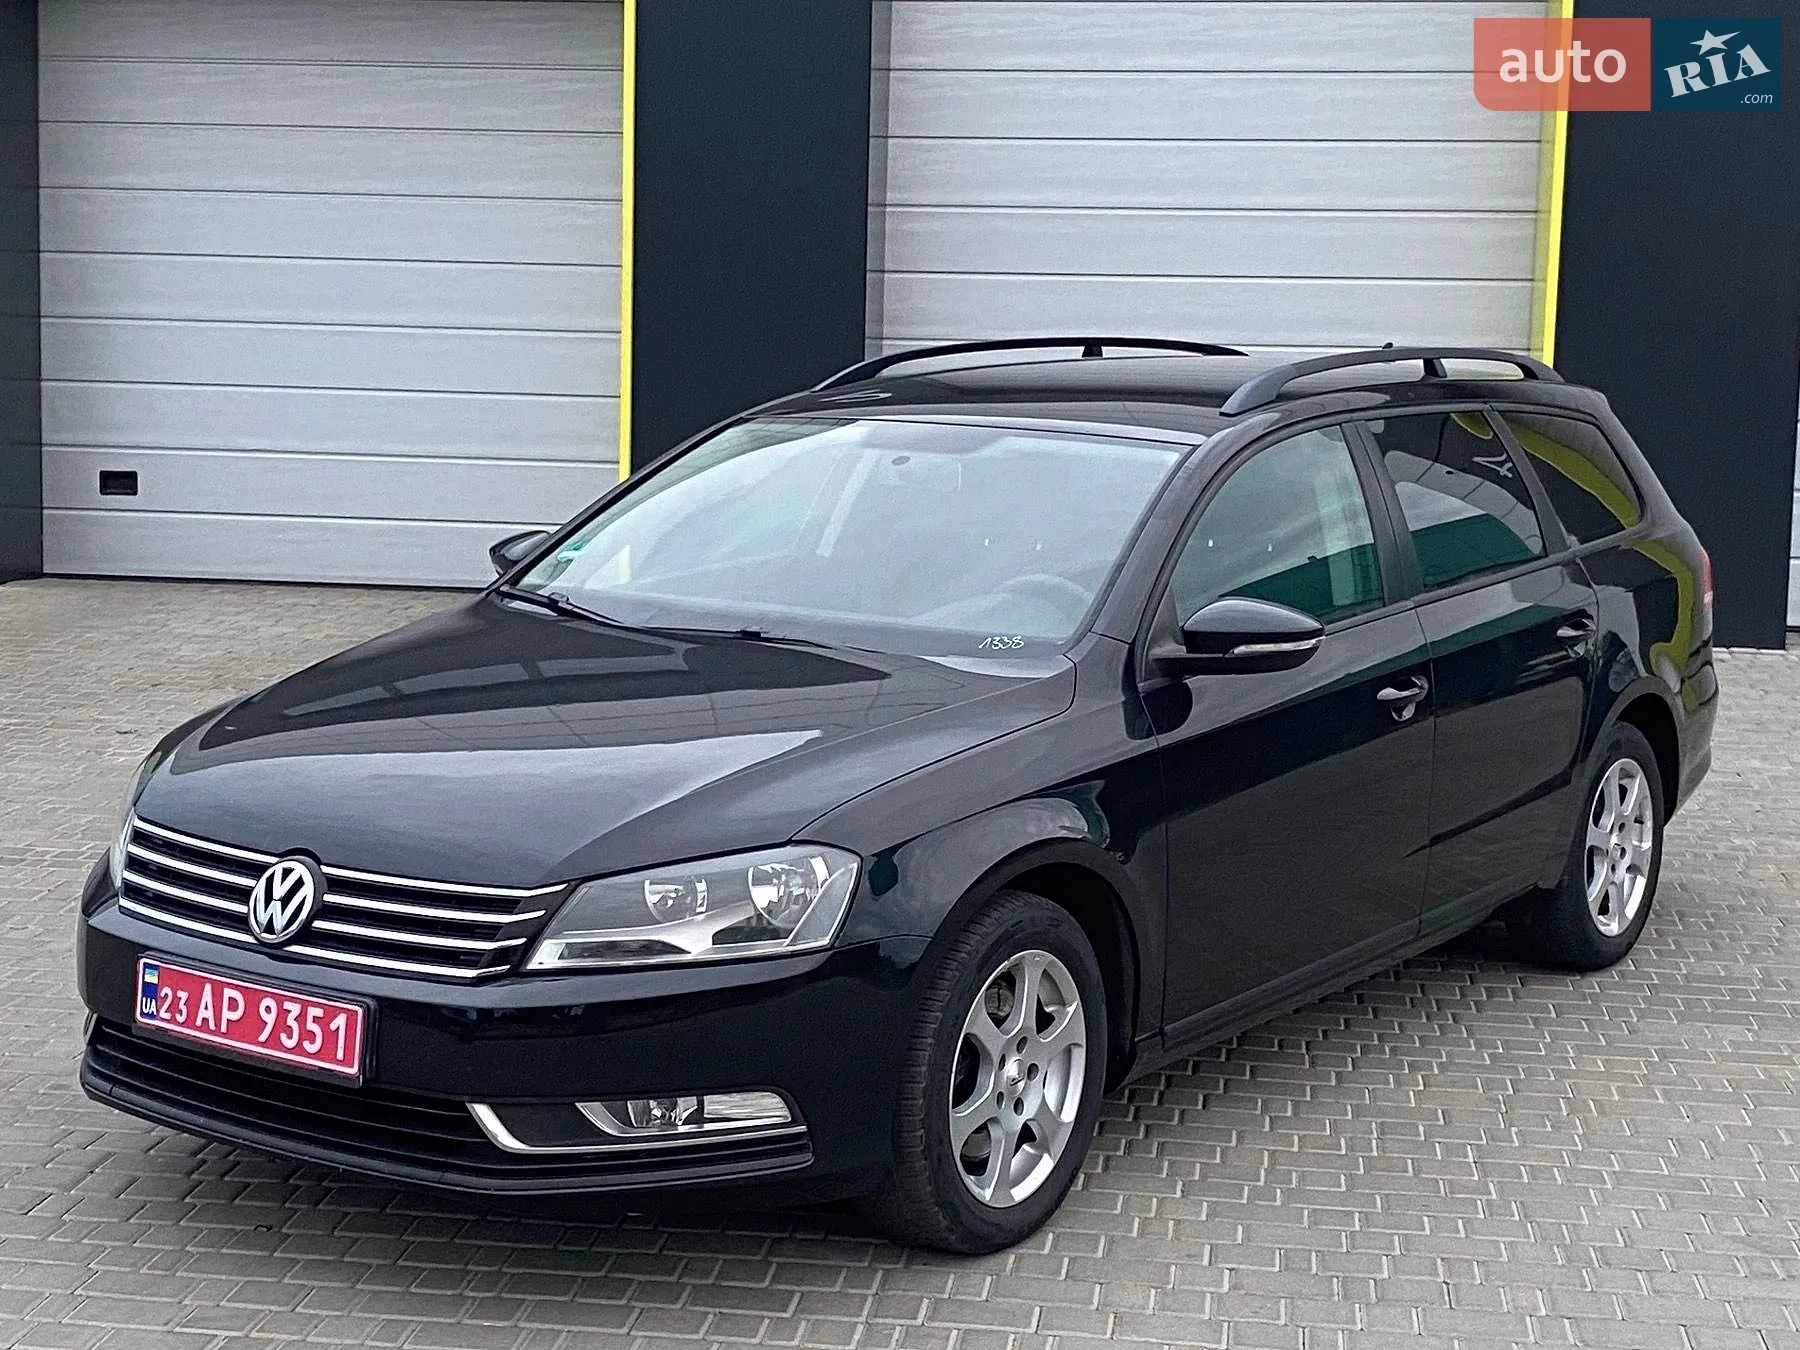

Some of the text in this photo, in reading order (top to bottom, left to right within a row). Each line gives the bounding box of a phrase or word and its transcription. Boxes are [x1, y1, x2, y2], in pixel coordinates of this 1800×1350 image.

[142, 997, 157, 1016] UA
[158, 983, 348, 1061] 23 AP 9351
